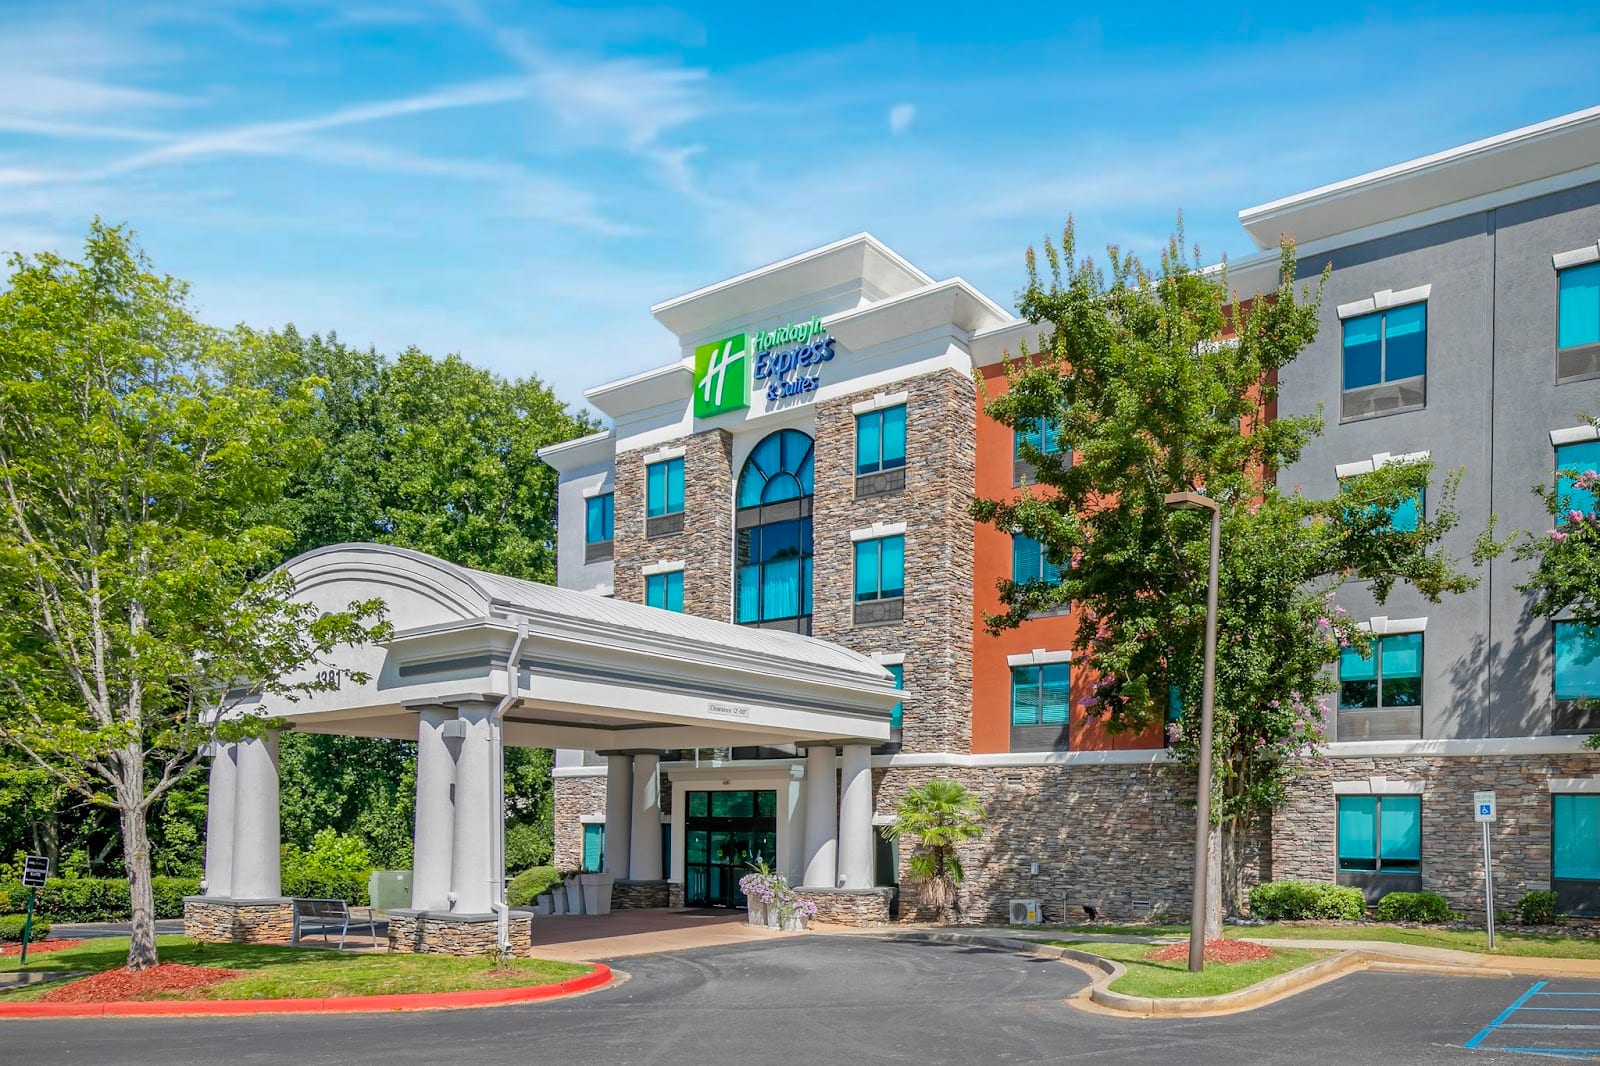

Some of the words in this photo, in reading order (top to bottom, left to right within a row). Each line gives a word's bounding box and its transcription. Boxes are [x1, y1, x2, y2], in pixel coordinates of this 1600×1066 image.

[754, 322, 810, 351] Holiday
[754, 338, 836, 380] Express
[780, 376, 820, 398] Suites
